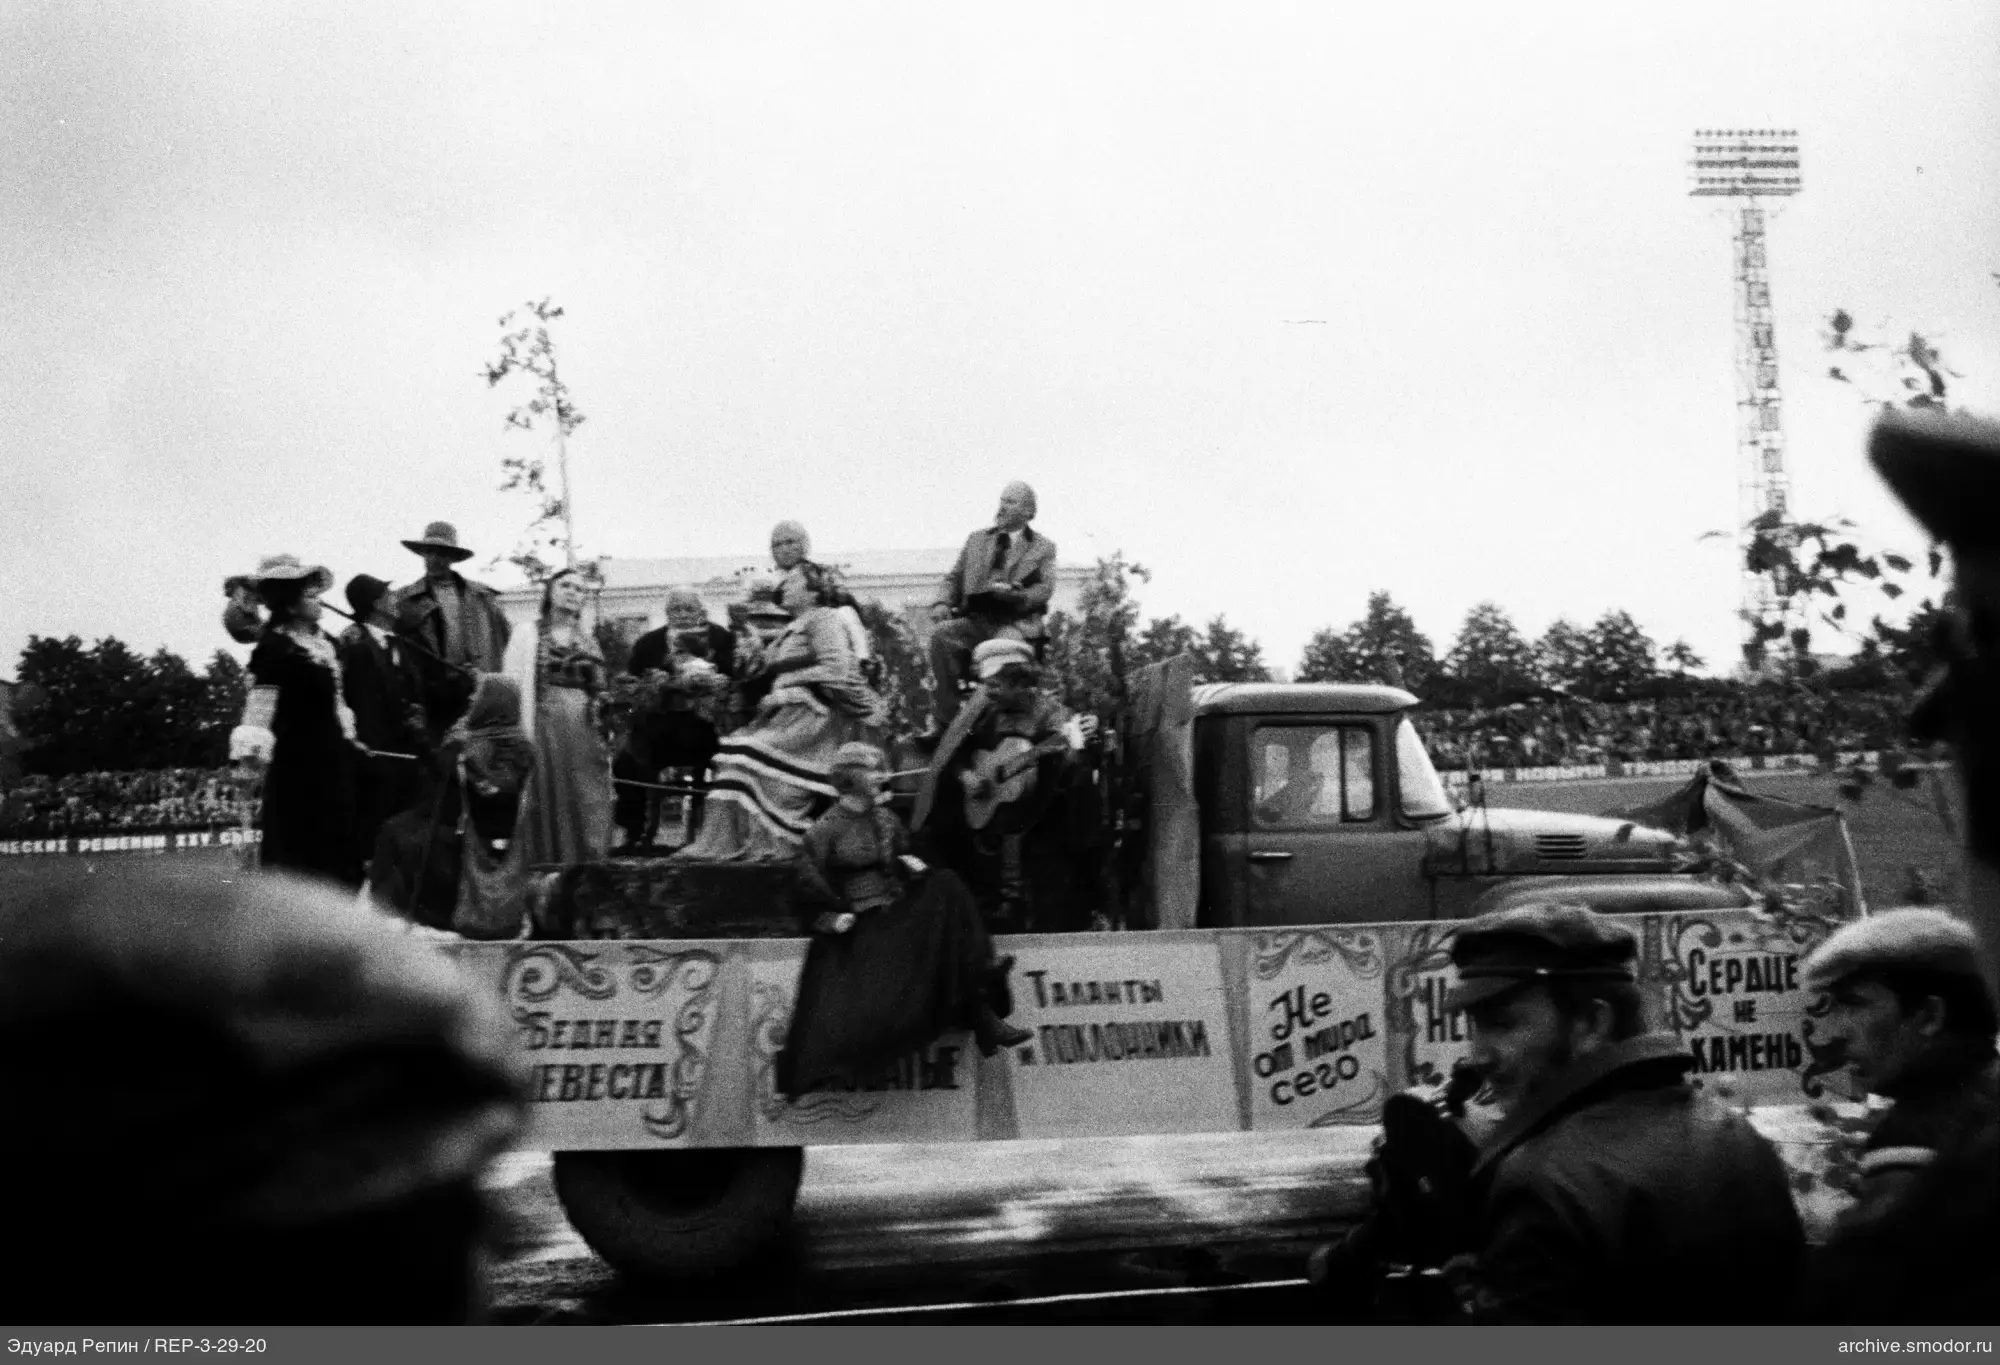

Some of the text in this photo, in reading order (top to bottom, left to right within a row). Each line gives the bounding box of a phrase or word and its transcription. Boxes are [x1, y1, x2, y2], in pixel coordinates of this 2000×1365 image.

[1269, 984, 1333, 1041] Не
[1733, 1001, 1758, 1023] НЕ
[1254, 1012, 1377, 1079] от мира
[1690, 1033, 1803, 1075] КАМЕНЬ
[1270, 1055, 1360, 1106] сего
